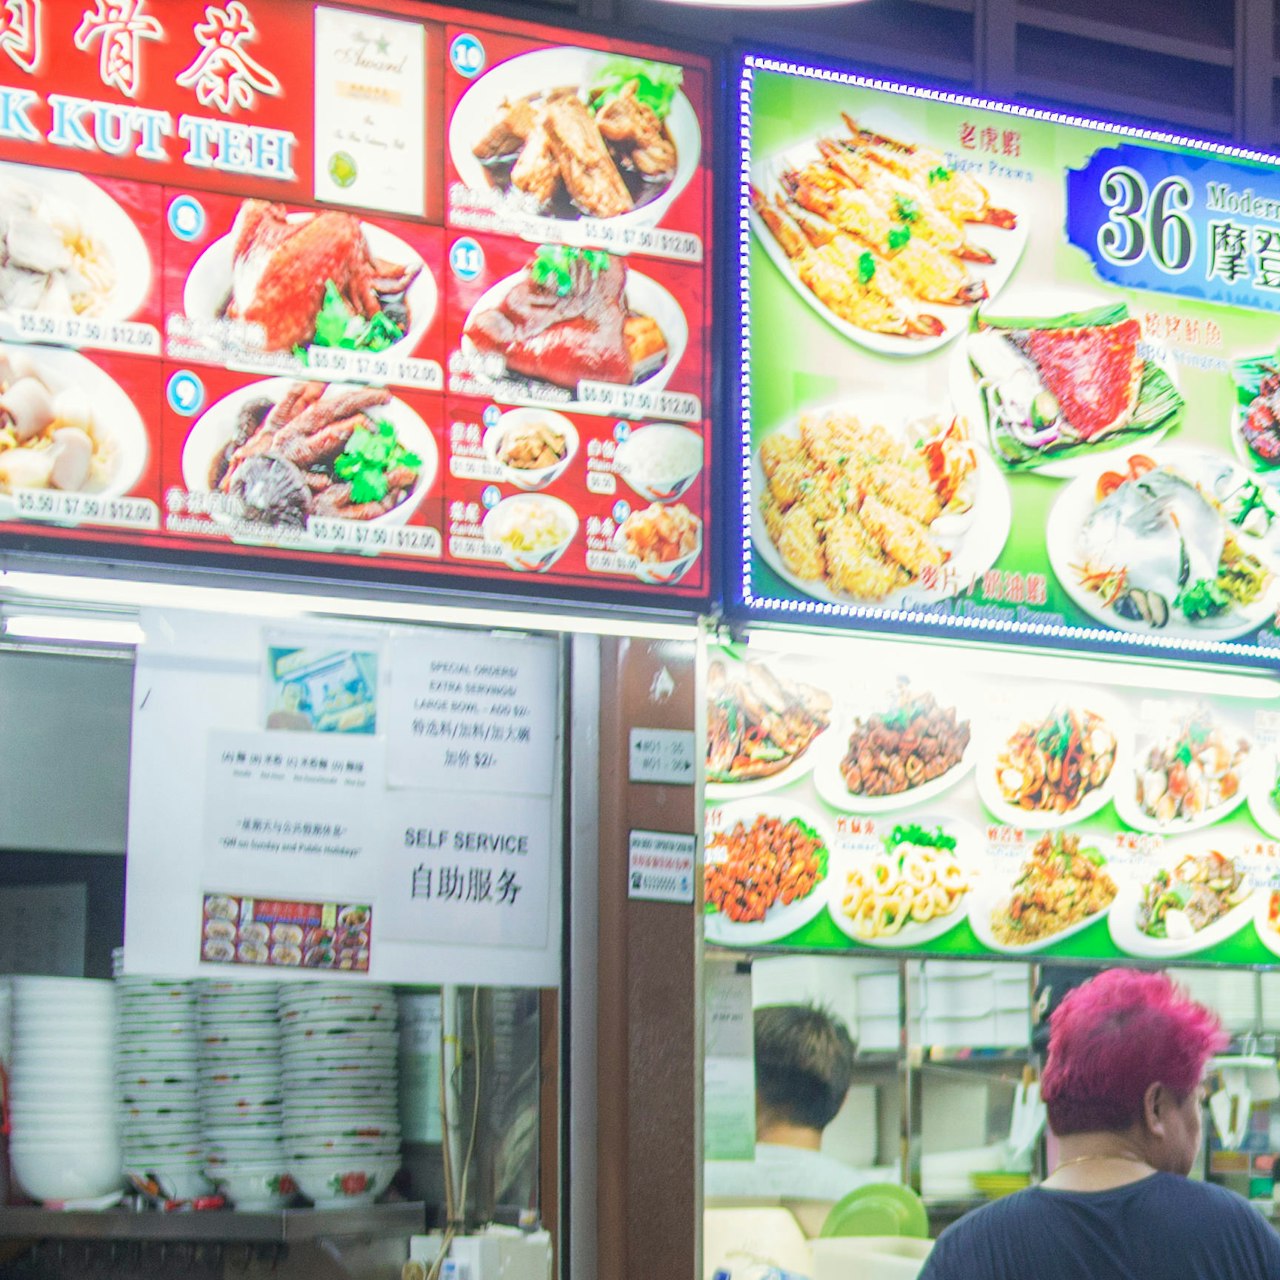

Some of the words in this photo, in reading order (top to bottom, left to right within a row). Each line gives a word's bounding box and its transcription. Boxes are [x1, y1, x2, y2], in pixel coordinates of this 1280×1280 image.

[455, 42, 482, 66] 10
[0, 86, 41, 143] K
[47, 93, 173, 160] KUT
[178, 114, 298, 181] TEH
[177, 205, 196, 231] 8
[1096, 166, 1197, 275] 36
[660, 236, 698, 255] $12.00
[455, 247, 479, 269] 11
[111, 326, 153, 346] $12.00
[1136, 342, 1167, 362] BBQ
[398, 364, 437, 382] $12.00
[176, 380, 197, 406] 9
[660, 397, 698, 416] $12.00
[110, 501, 152, 522] $12.00
[397, 531, 436, 550] $12.00
[429, 660, 471, 676] SPECIAL
[429, 679, 463, 694] EXTRA
[414, 697, 448, 713] LARGE
[449, 700, 479, 715] BOWL
[250, 839, 281, 854] Sunday
[281, 840, 297, 852] and
[298, 842, 323, 855] Public
[404, 828, 450, 851] SELF
[453, 831, 529, 856] SERVICE
[410, 862, 523, 907] 自助服务
